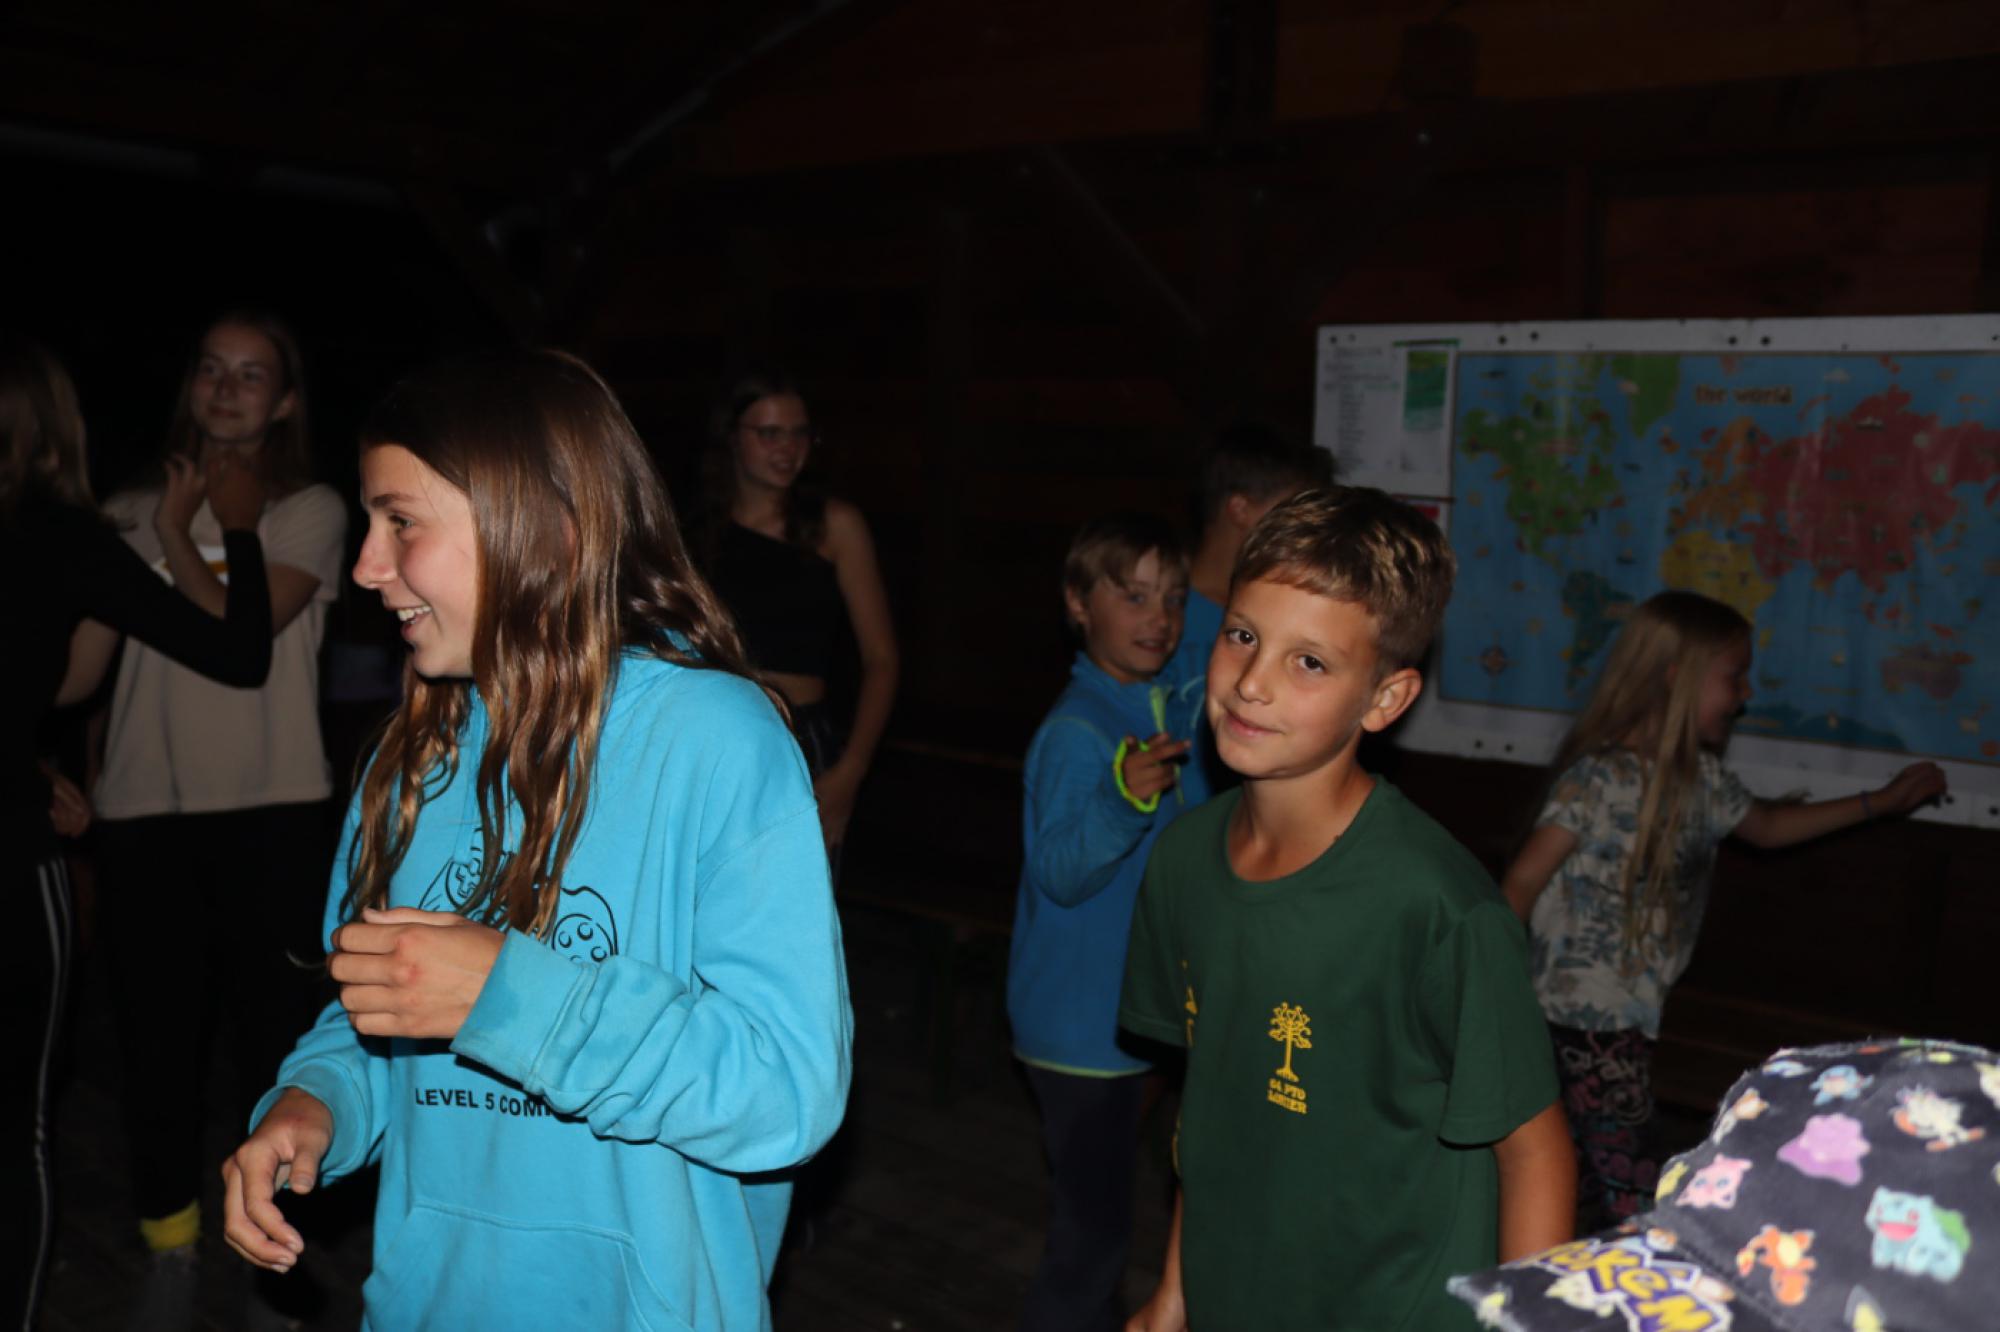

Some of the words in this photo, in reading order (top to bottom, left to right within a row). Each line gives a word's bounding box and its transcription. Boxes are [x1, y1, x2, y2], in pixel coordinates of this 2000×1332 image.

[1732, 384, 1793, 405] world
[415, 1088, 479, 1108] LEVEL
[485, 1092, 495, 1111] 5
[500, 1096, 552, 1117] COM
